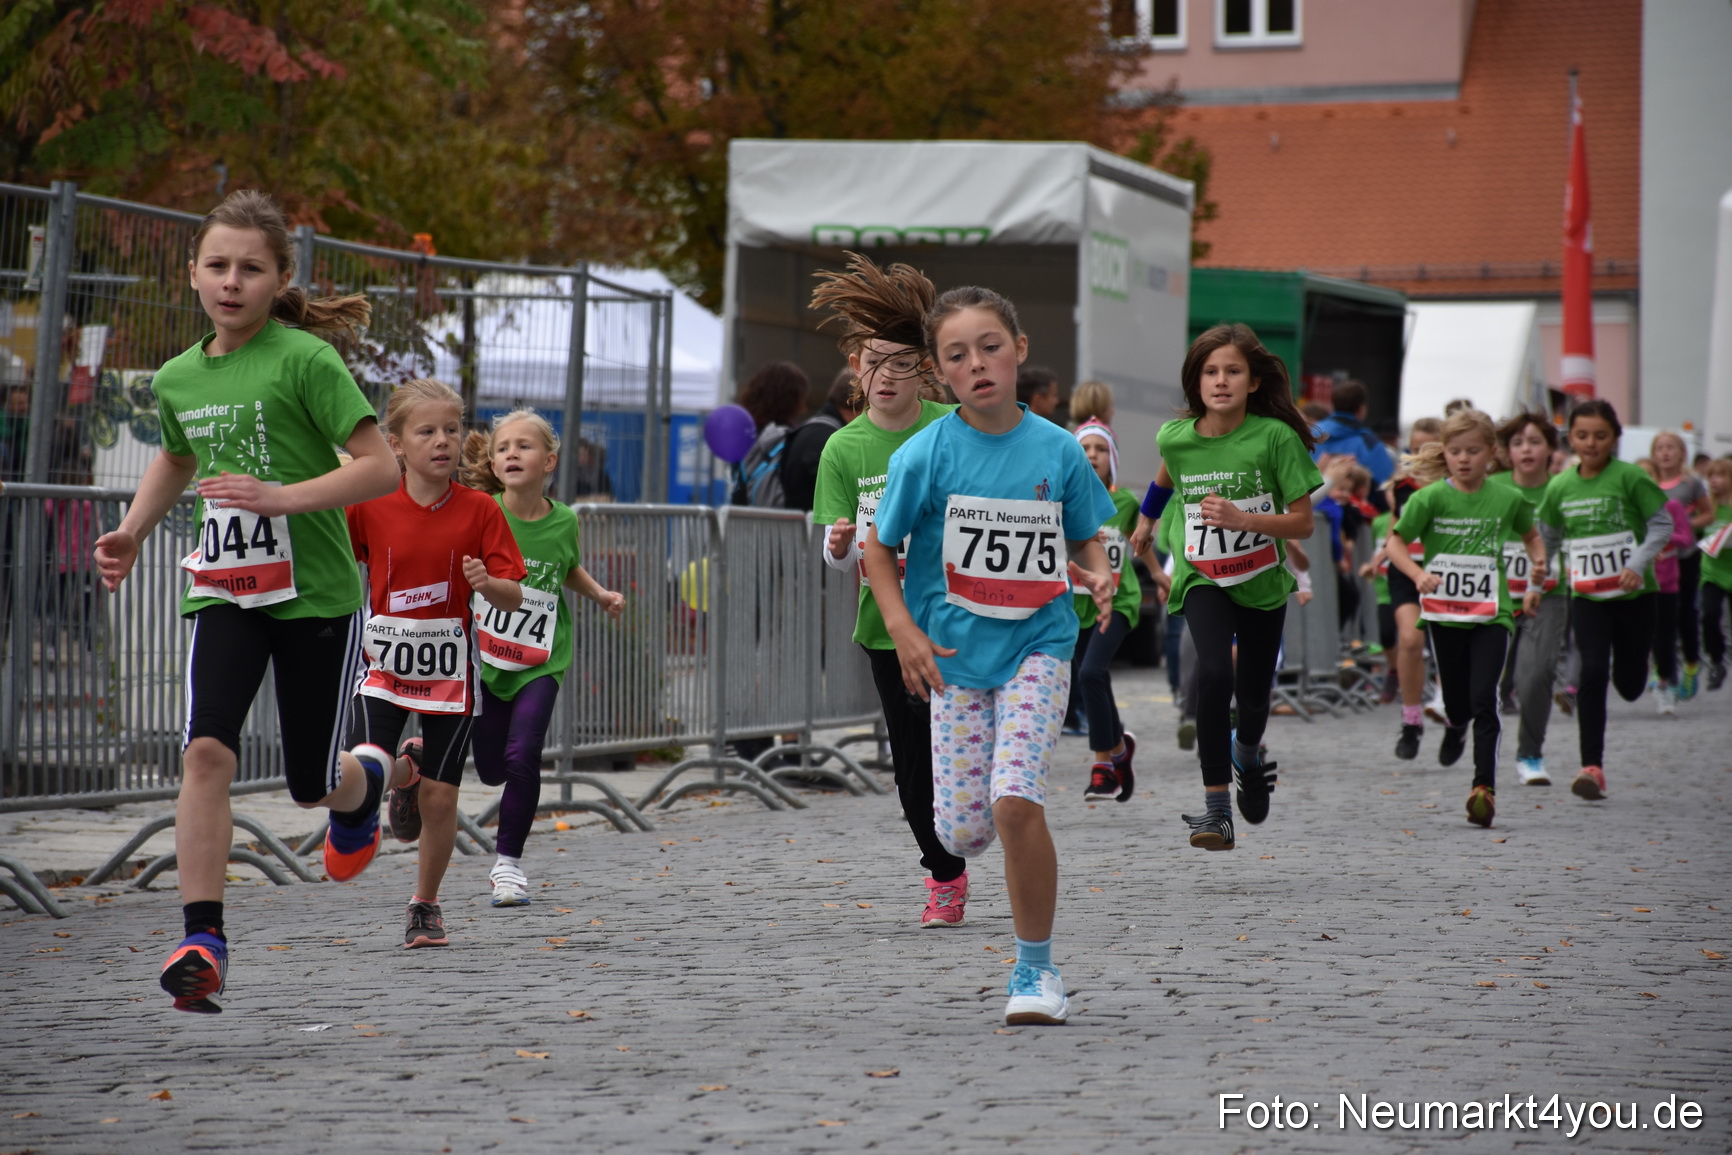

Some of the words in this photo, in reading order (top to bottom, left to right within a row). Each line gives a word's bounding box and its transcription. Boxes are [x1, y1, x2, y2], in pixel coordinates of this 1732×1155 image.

[176, 404, 229, 422] umarkter
[254, 400, 270, 475] BAMBINI
[1181, 471, 1234, 484] Neumarkter
[1182, 483, 1222, 496] Stadtlauf
[949, 507, 993, 521] PARTL
[996, 511, 1051, 525] Neumarkt
[199, 514, 278, 564] 044
[959, 526, 1057, 575] 7575
[1213, 559, 1254, 575] Leonie
[973, 581, 1014, 605] Anja
[1431, 571, 1491, 598] 7054
[405, 591, 432, 604] DEHN
[366, 623, 399, 637] PARTL
[401, 628, 450, 638] Neumarkt
[373, 639, 458, 676] 7090
[488, 639, 523, 661] Sophia
[393, 680, 432, 697] Paula
